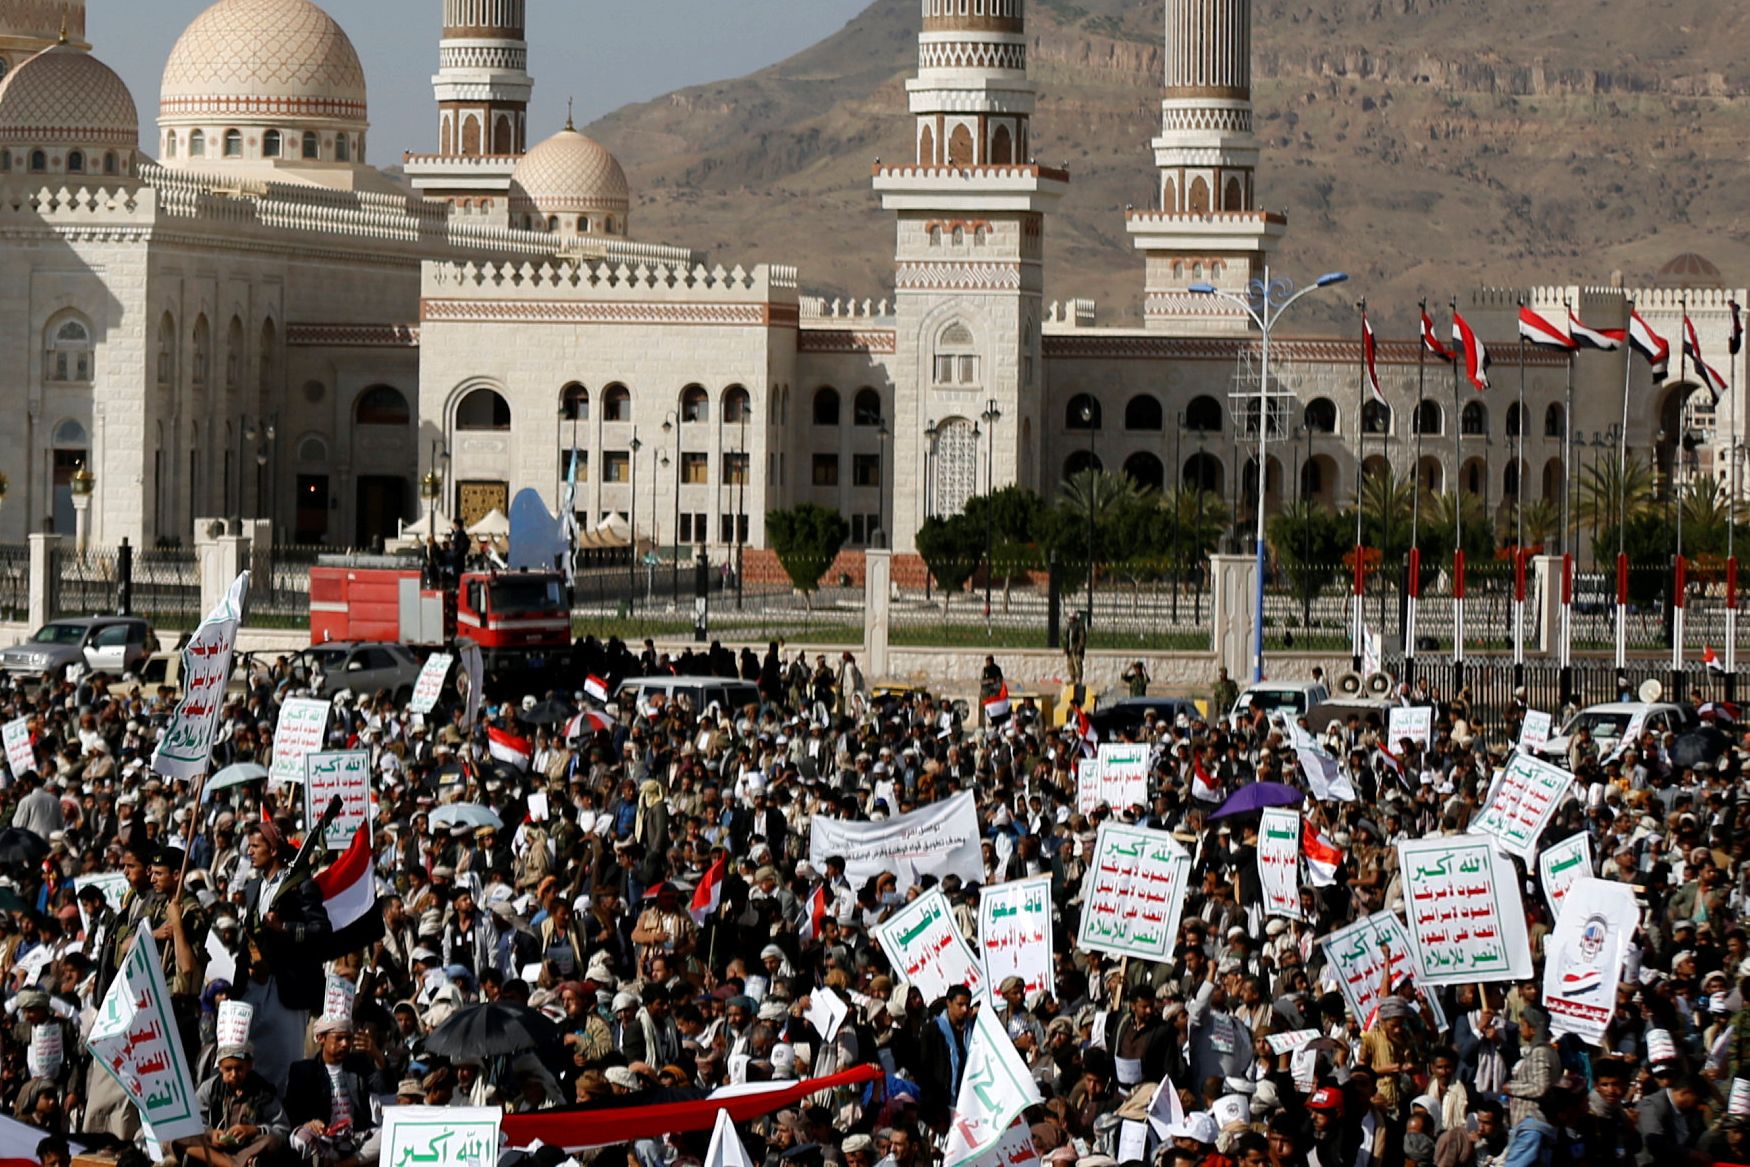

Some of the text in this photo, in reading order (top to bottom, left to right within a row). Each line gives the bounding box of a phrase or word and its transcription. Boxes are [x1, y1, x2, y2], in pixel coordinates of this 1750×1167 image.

[1263, 818, 1296, 843] قاطعوا
[1105, 837, 1172, 862] لله أكبر
[1142, 869, 1174, 885] الموت
[1411, 853, 1488, 884] الله أكبر
[1138, 887, 1170, 904] الموت
[1457, 880, 1491, 898] الموت
[1092, 899, 1166, 924] اللعنة على اليهود
[1461, 902, 1495, 920] الموت
[890, 897, 942, 952] قاطعوا
[1128, 926, 1163, 945] النصر
[1421, 924, 1498, 946] اللعنة على اليهود
[1341, 932, 1371, 968] أكبر
[1425, 943, 1503, 972] النصر للإسلام
[393, 1126, 492, 1167] الله أكبر
